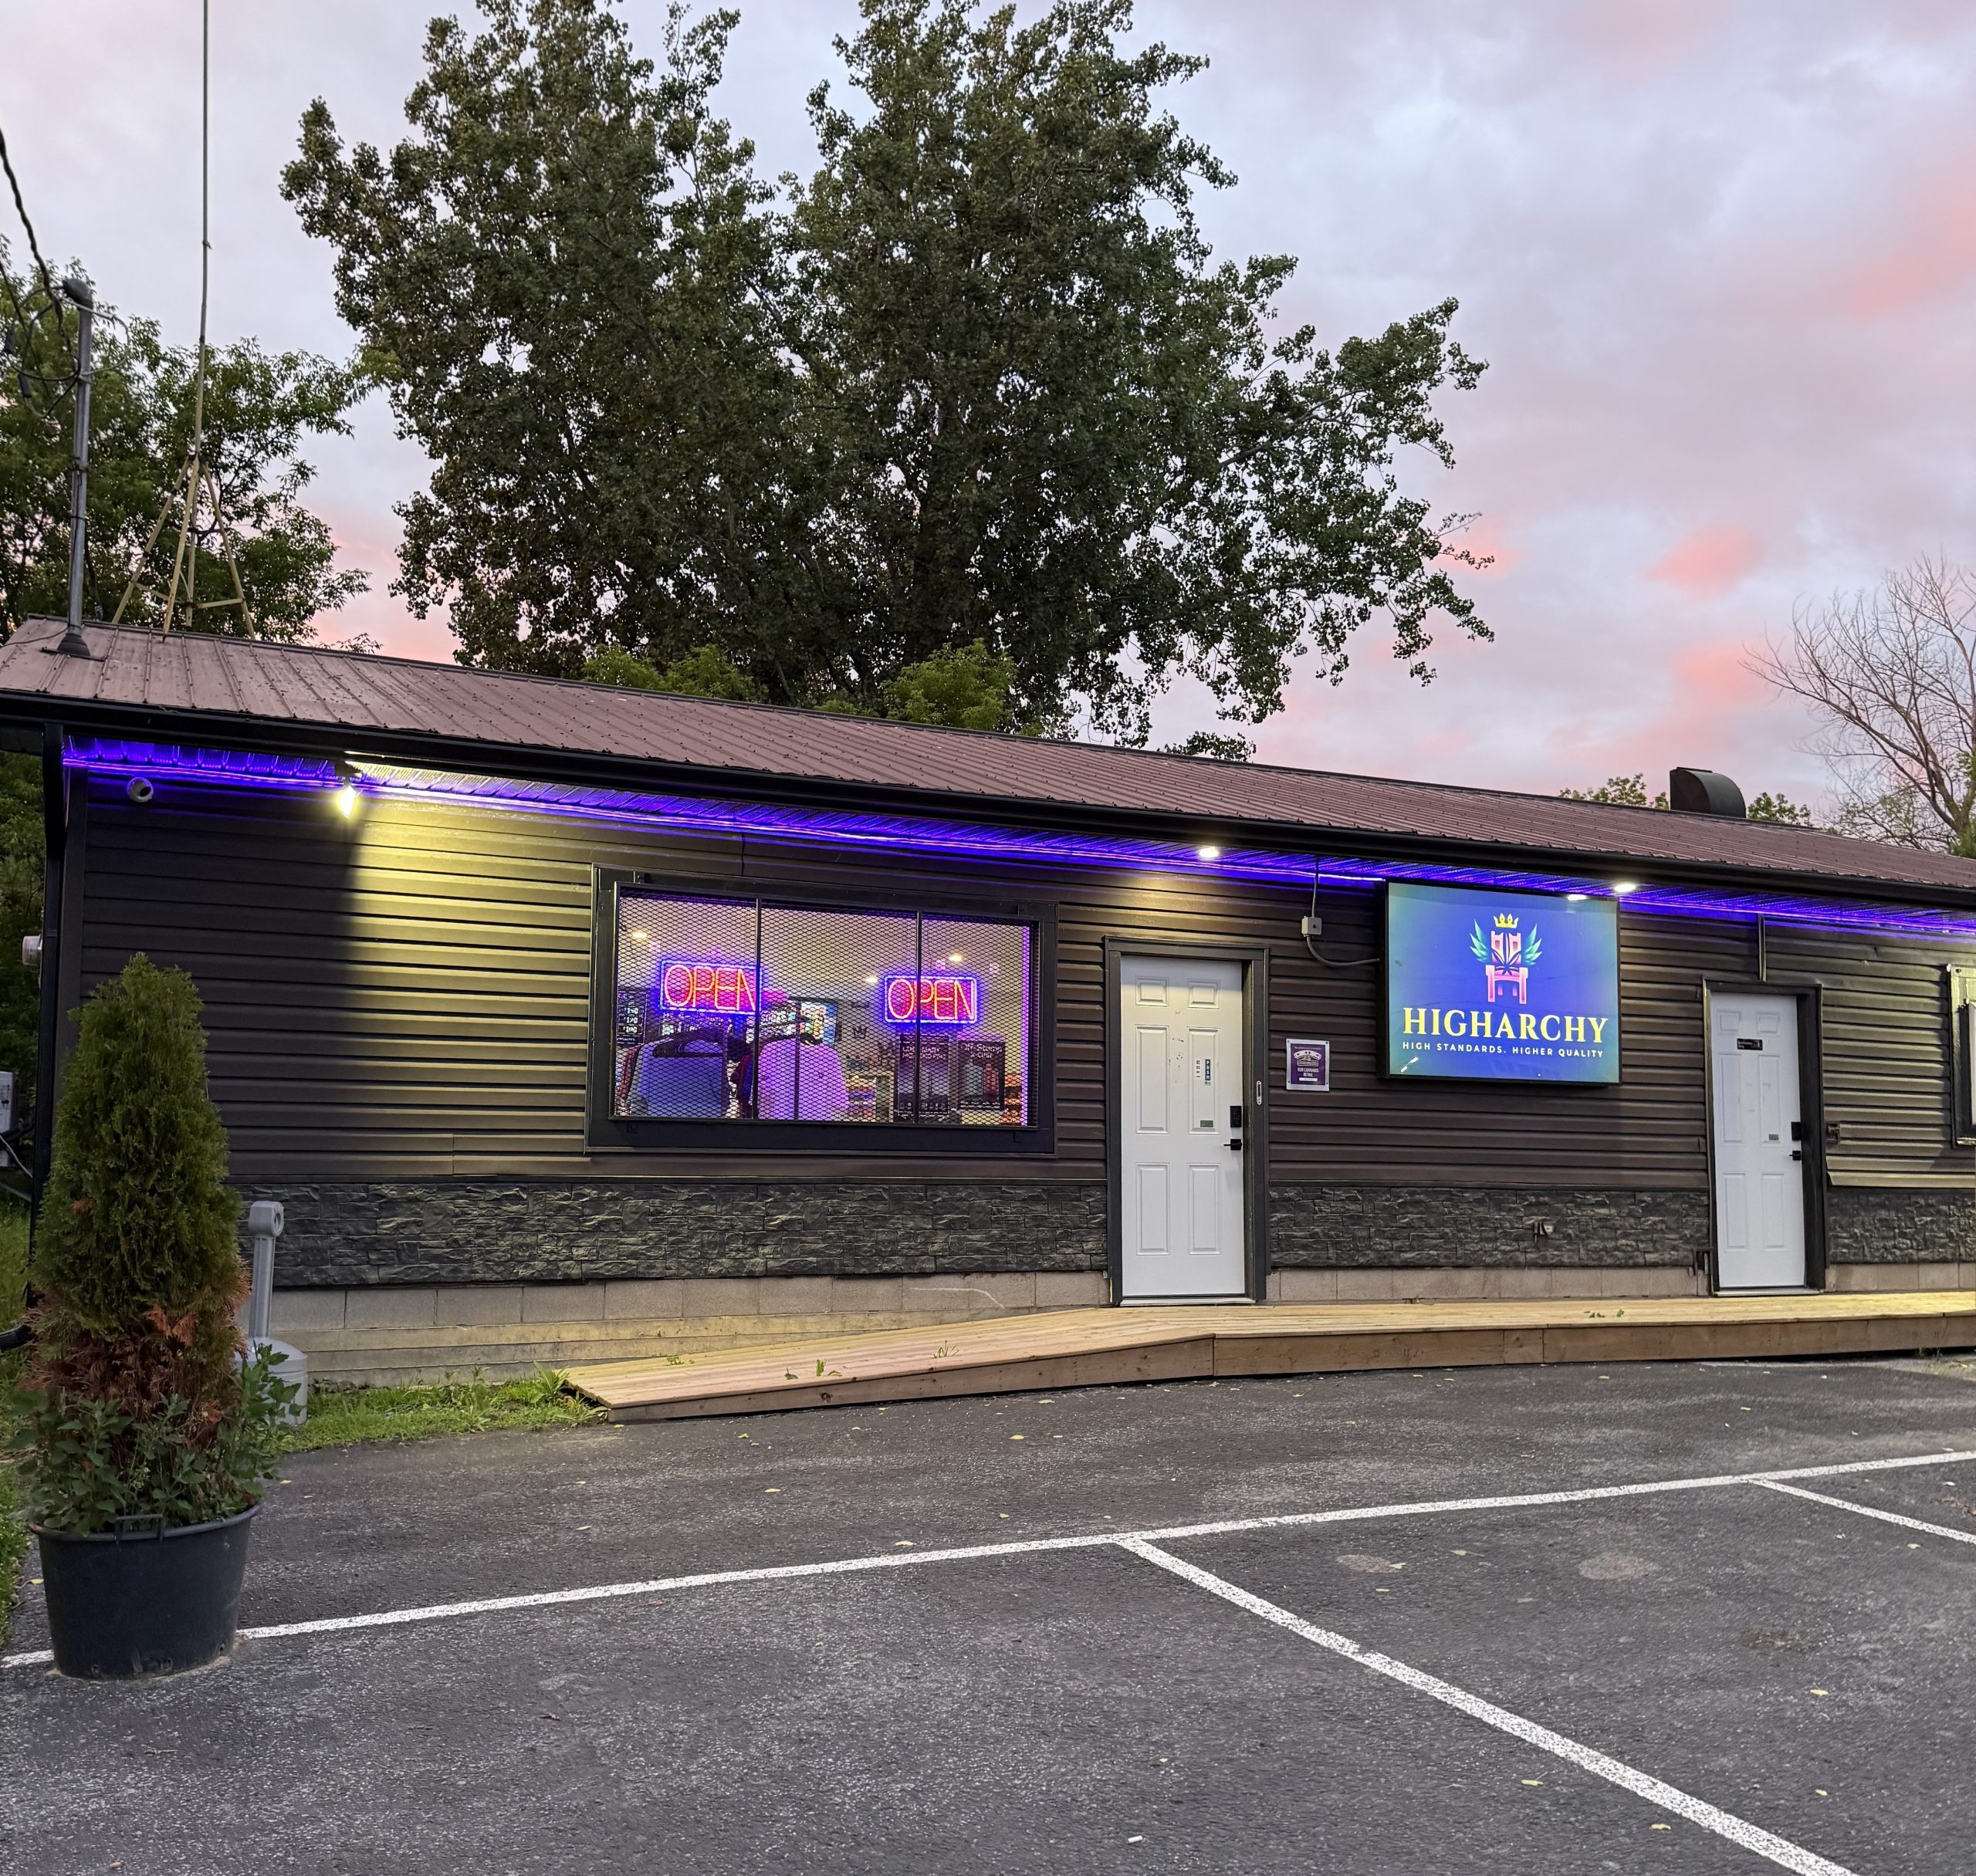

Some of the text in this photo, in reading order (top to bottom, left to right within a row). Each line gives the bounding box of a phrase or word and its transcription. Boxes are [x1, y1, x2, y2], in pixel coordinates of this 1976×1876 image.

[664, 964, 756, 1012] OPEN
[888, 979, 974, 1020] OPEN
[1402, 1007, 1609, 1043] HIGHARCHY
[1402, 1042, 1603, 1057] HIGH STANDARDS. HIGHER QUALITY
